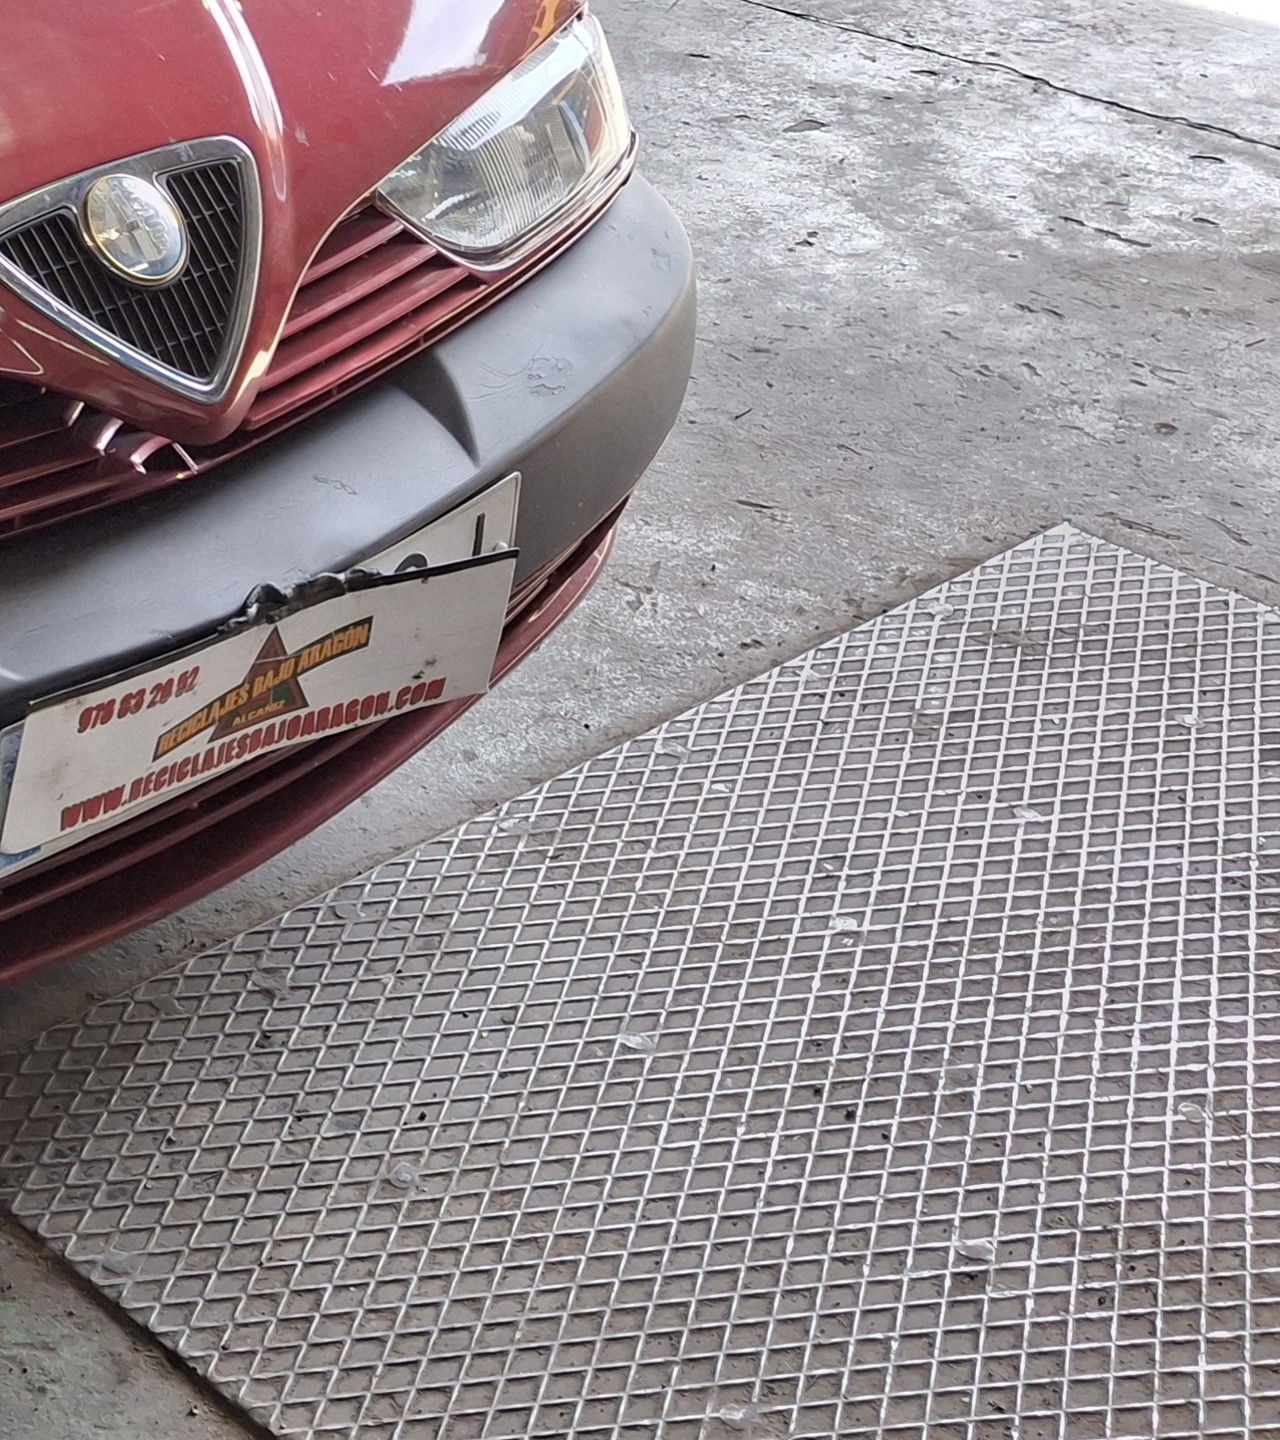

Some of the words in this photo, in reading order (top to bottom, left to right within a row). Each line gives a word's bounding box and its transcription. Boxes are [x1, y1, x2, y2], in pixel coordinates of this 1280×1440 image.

[157, 682, 250, 754] RECICLAJES
[252, 656, 296, 700] BAJO
[297, 621, 370, 673] ARAGÓN
